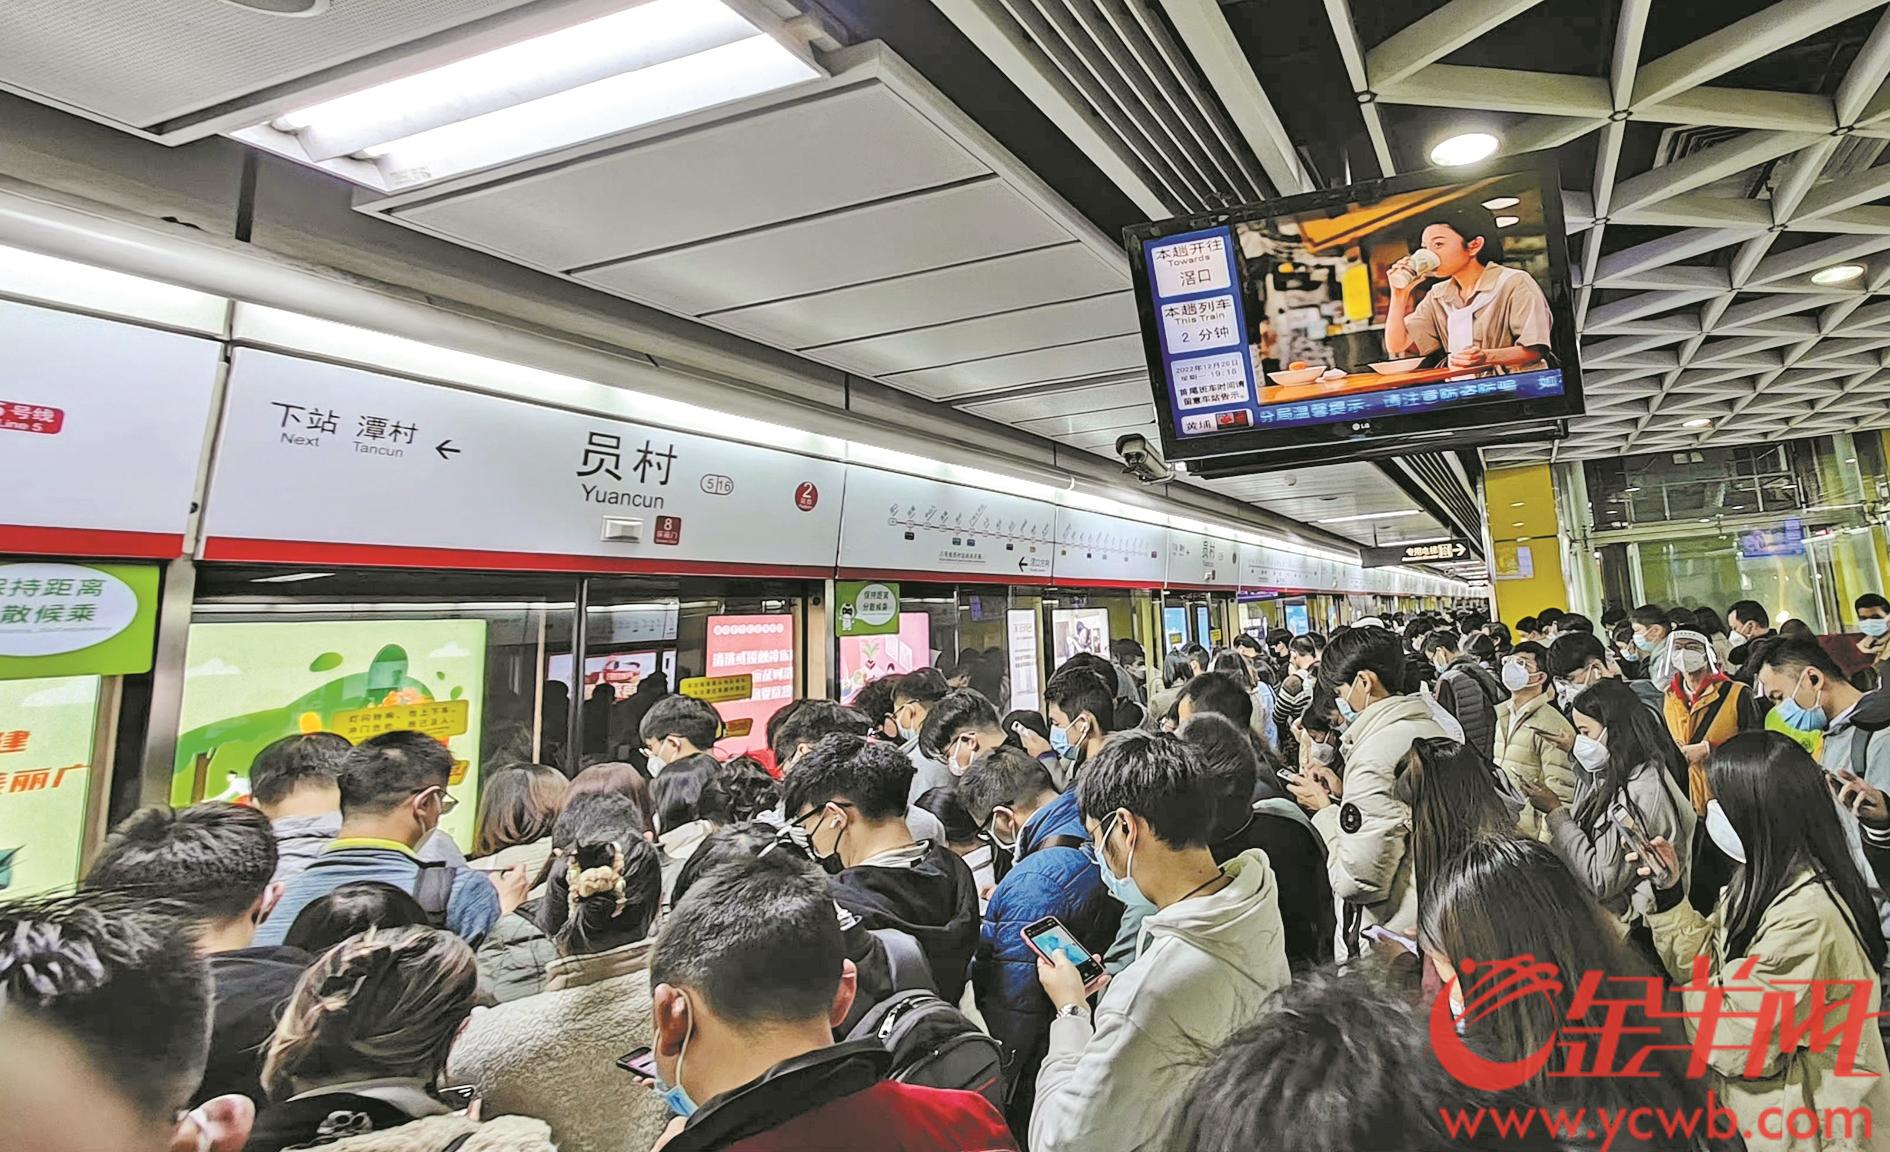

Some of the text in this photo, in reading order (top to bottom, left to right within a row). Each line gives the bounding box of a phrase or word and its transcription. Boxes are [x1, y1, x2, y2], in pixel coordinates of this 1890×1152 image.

[1168, 255, 1210, 267] Towards
[1180, 269, 1211, 287] 滘口
[1175, 312, 1225, 325] This Train
[1181, 326, 1229, 343] 2 分钟
[31, 422, 44, 431] 5
[271, 401, 419, 445] 下站 潭村
[280, 432, 404, 458] Next Tancun
[576, 431, 679, 486] 员村
[581, 483, 665, 510] Yuancun
[801, 482, 813, 498] 2
[663, 518, 673, 531] 8
